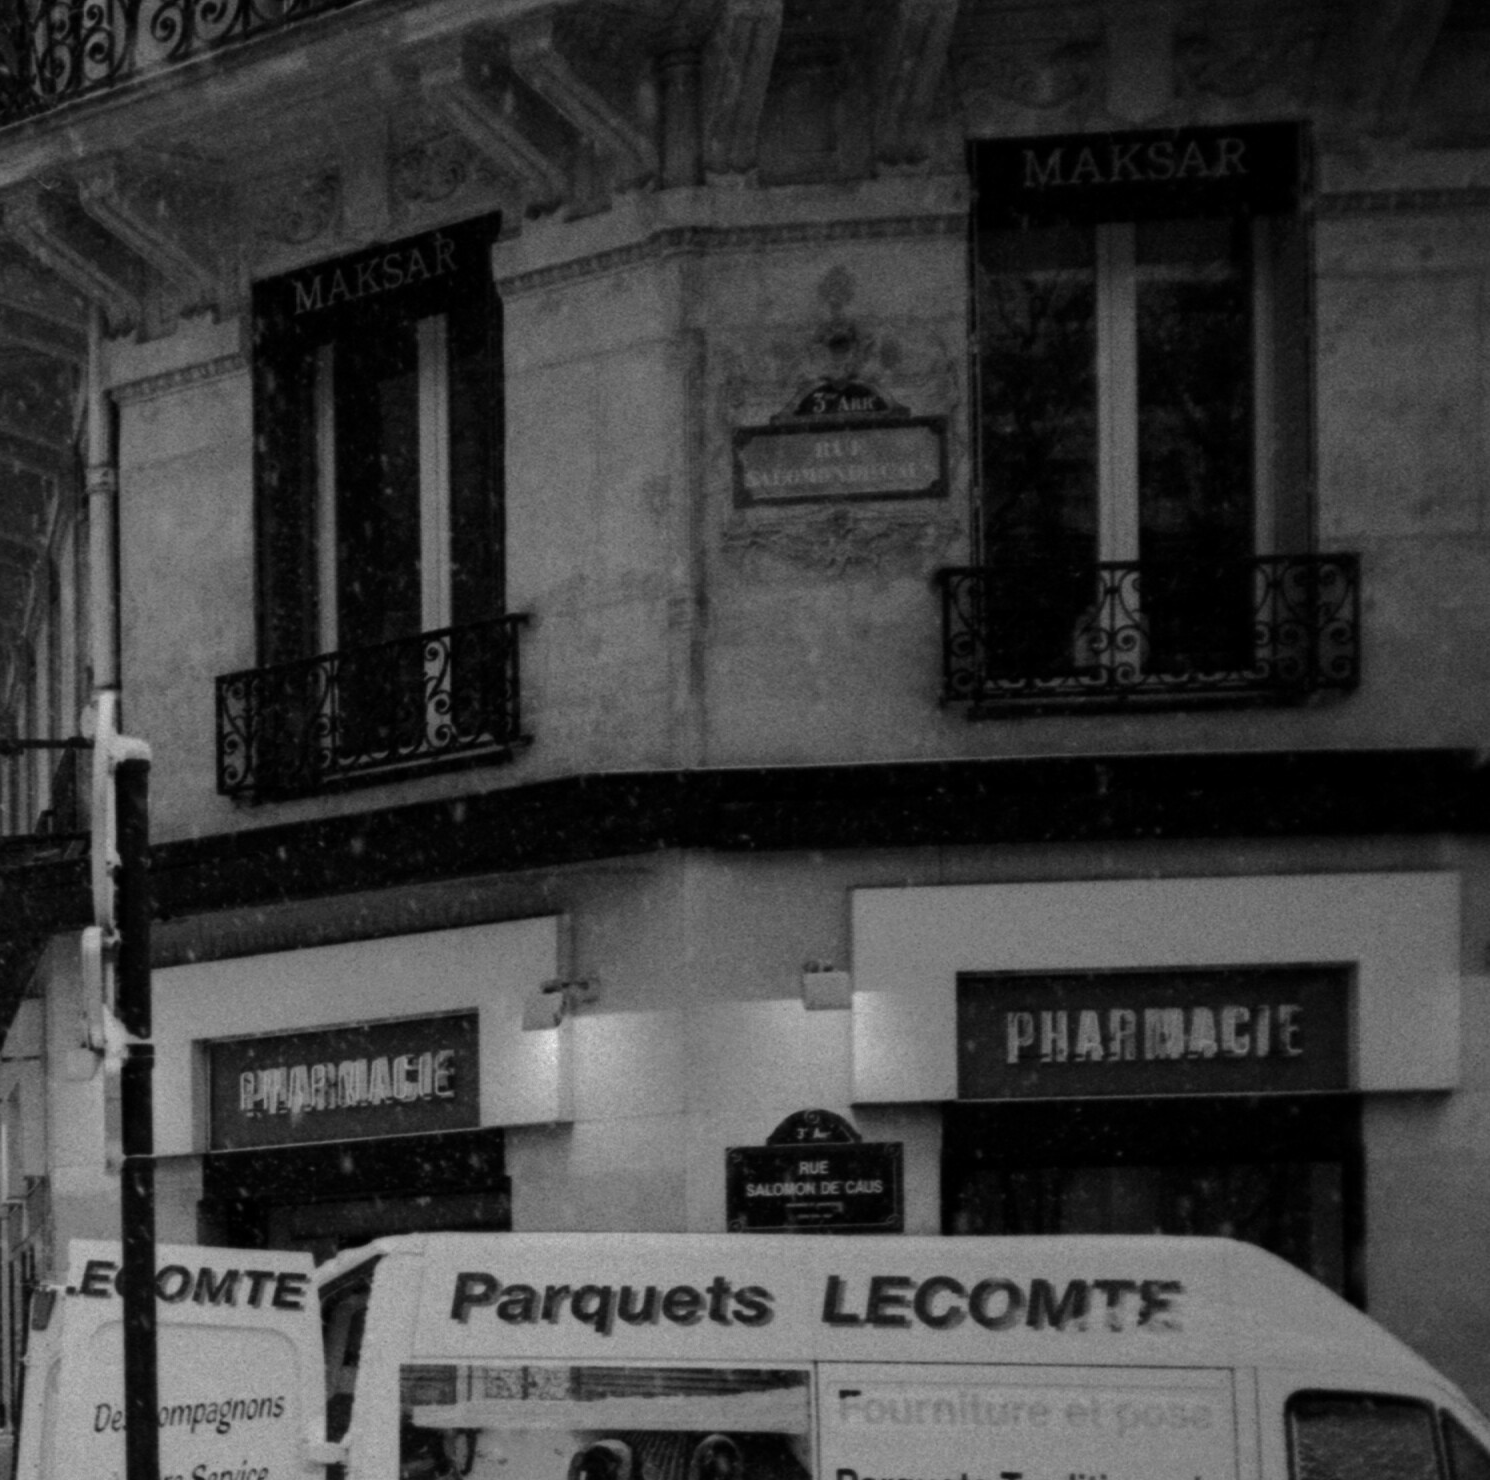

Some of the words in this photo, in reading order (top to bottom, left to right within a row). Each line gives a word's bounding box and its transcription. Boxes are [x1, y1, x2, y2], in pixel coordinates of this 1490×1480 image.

[1023, 137, 1249, 189] MAKSAR
[293, 237, 457, 317] MAKSAR
[1006, 1002, 1307, 1065] PHARMACIE
[238, 1048, 455, 1118] PHARMACIE
[745, 1182, 816, 1198] SALOMON
[821, 1180, 841, 1195] DE
[845, 1179, 885, 1195] CAUS
[799, 1160, 830, 1175] RUE
[65, 1259, 310, 1311] EOMTE
[450, 1270, 777, 1337] Parquets
[821, 1274, 1188, 1334] LECOMTE
[157, 1396, 285, 1435] ompagnons
[838, 1389, 1052, 1431] Fourniture
[1065, 1394, 1105, 1431] et
[1118, 1400, 1214, 1441] pose
